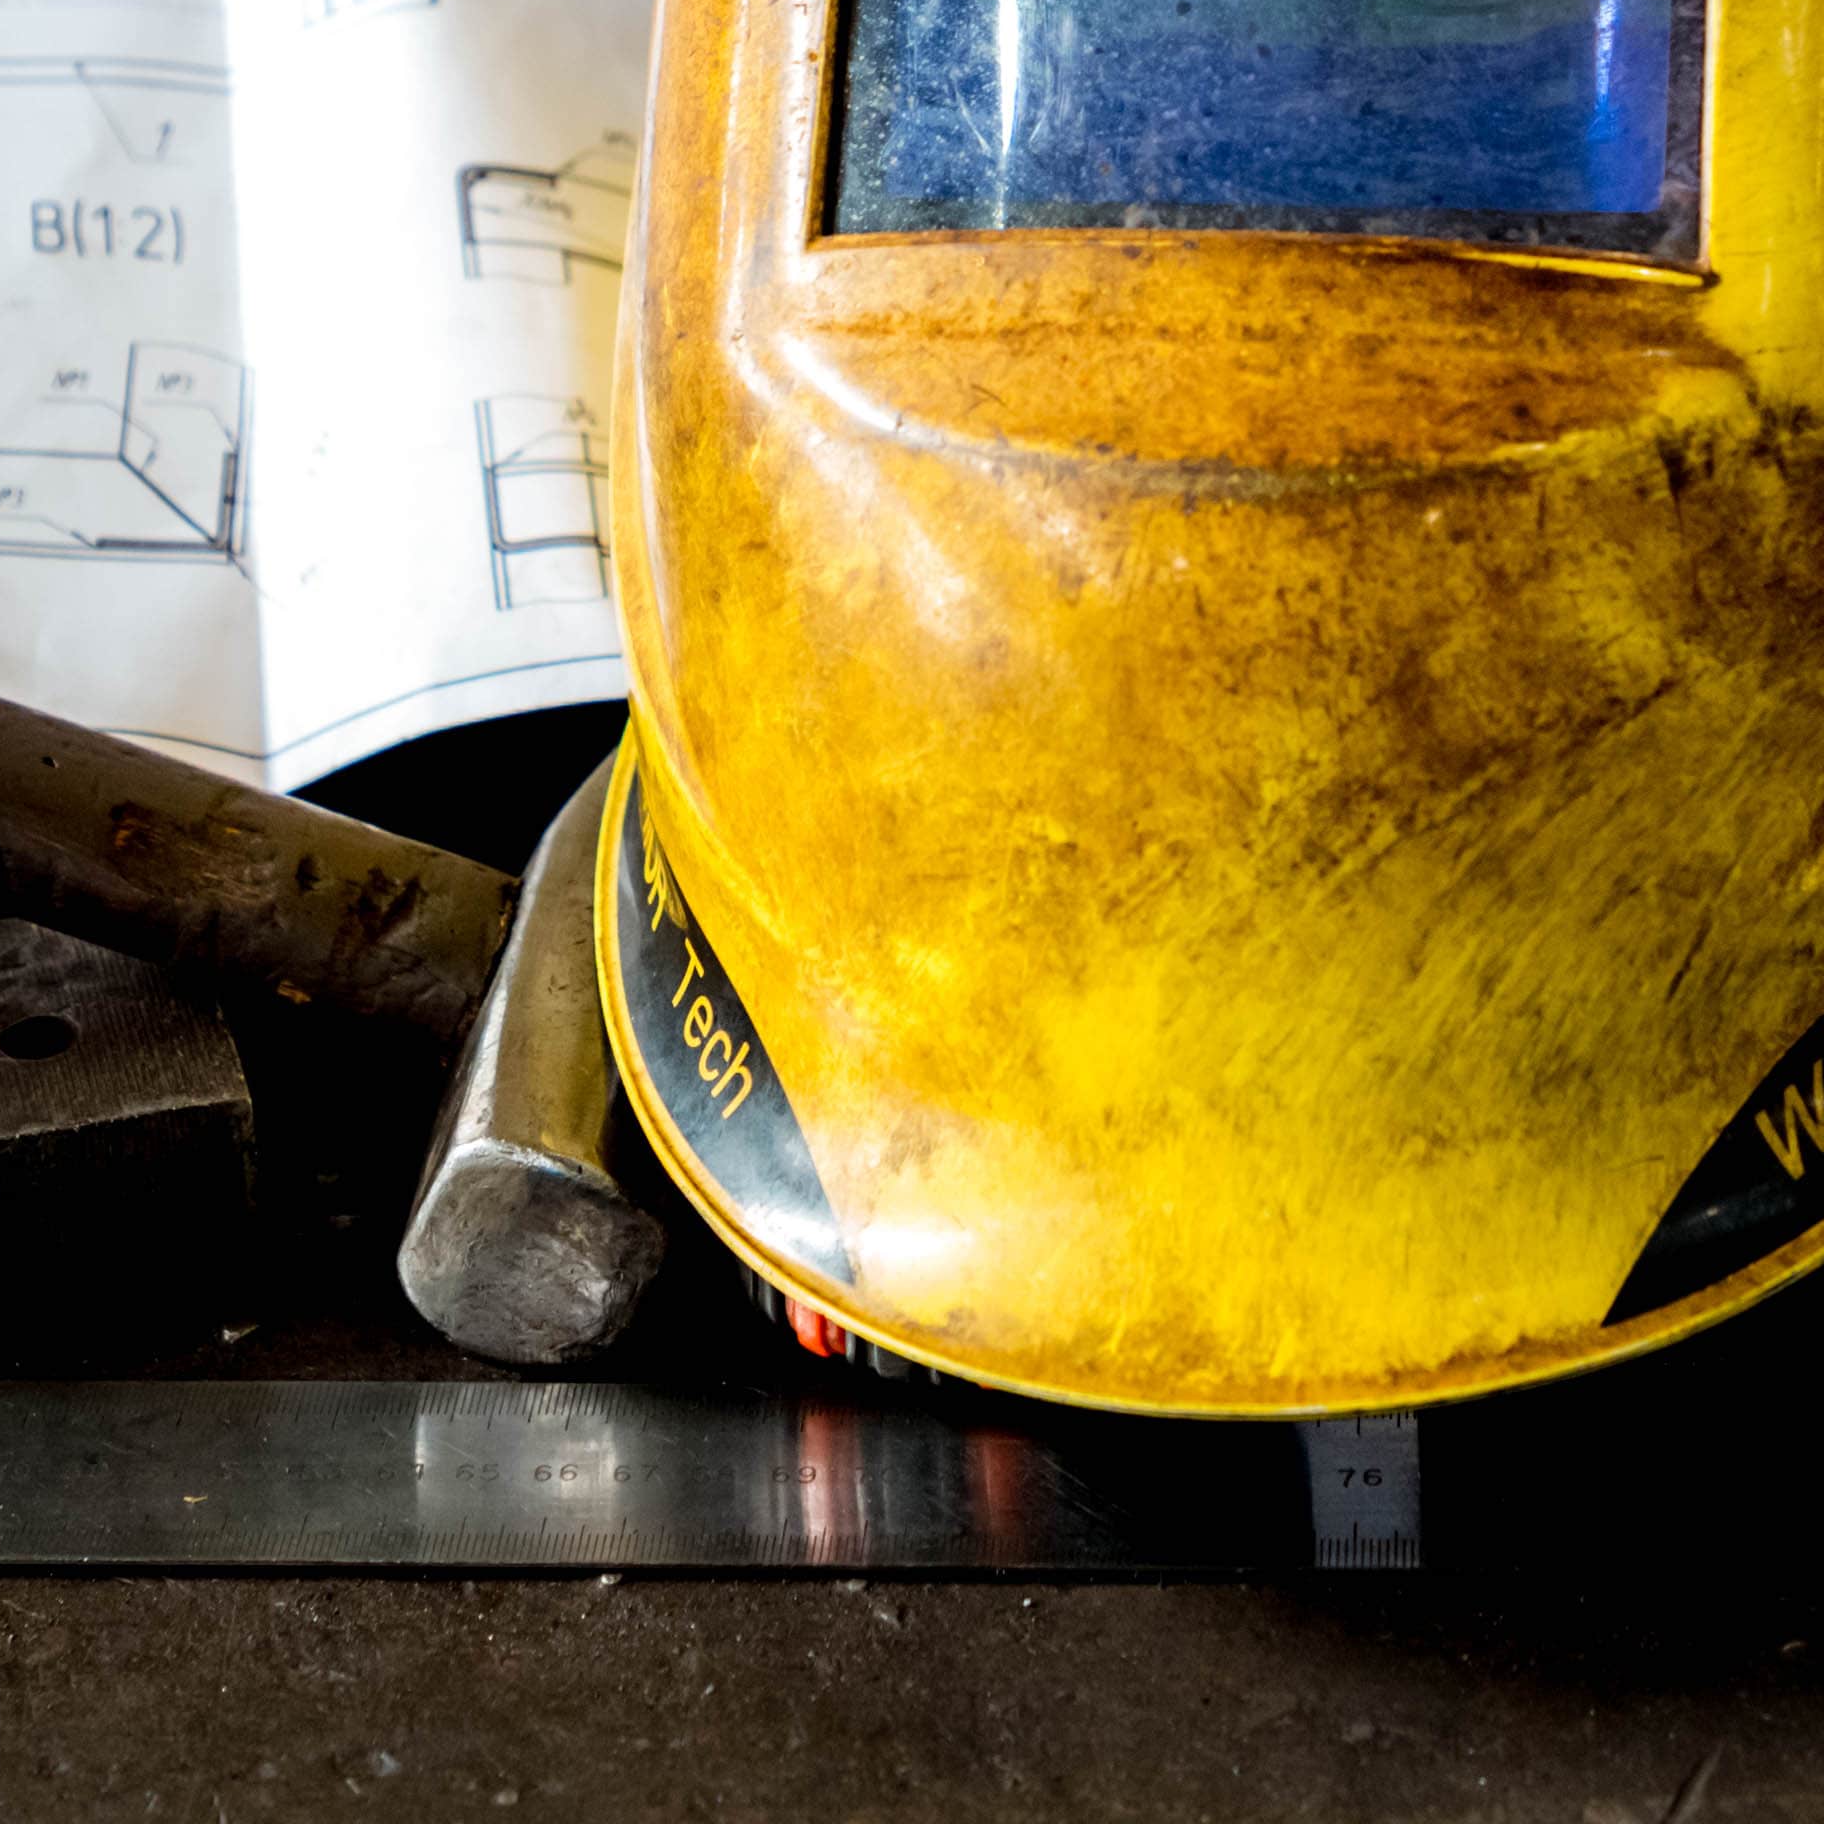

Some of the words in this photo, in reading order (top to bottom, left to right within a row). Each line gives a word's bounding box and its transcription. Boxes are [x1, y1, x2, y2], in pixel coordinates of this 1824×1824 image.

[671, 937, 754, 1120] Tech
[455, 1462, 501, 1482] 65
[534, 1462, 580, 1484] 66
[613, 1463, 659, 1484] 67
[771, 1464, 818, 1485] 69
[1337, 1468, 1383, 1487] 76
